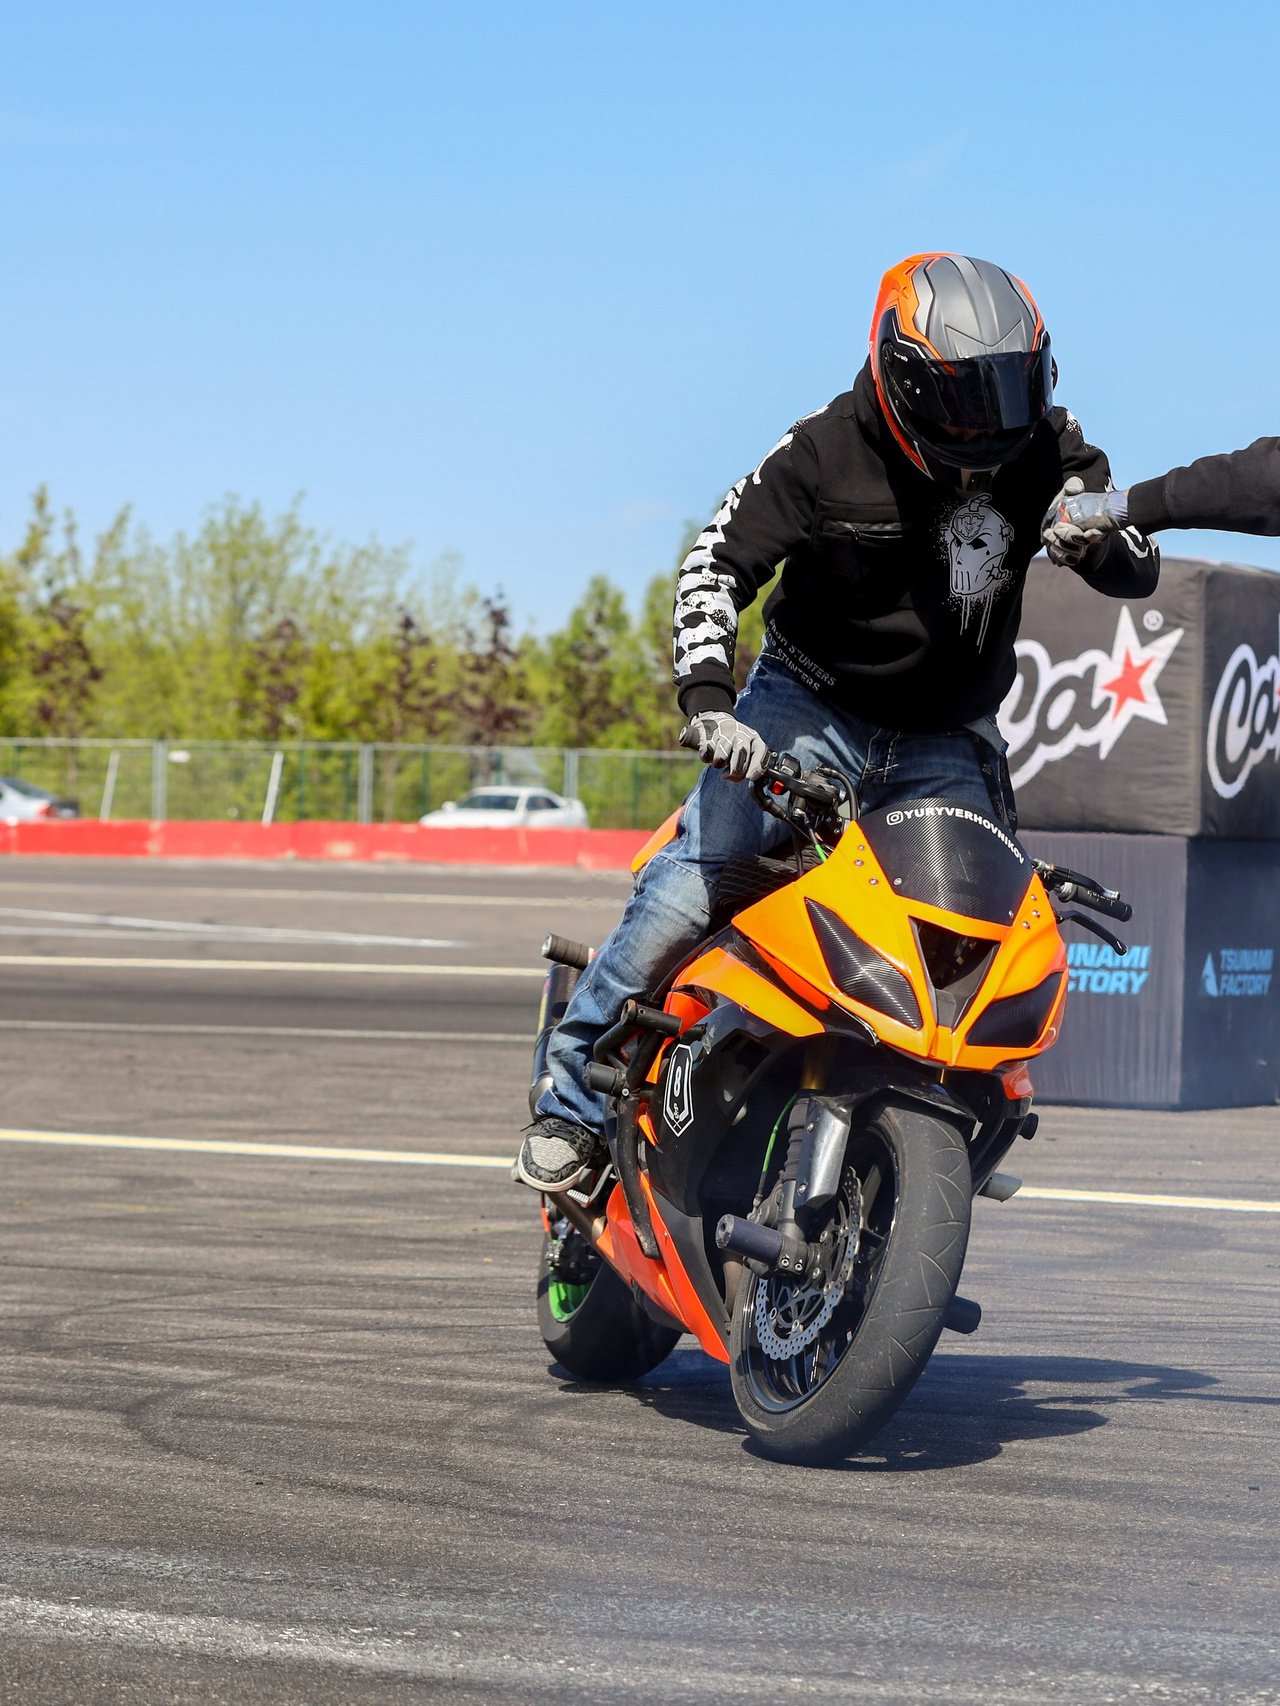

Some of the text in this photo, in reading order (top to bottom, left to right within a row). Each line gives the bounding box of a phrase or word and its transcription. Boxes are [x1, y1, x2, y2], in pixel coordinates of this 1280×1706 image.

[769, 618, 836, 686] FROM STUNTERS
[777, 648, 820, 691] STUNTERS
[1220, 949, 1274, 971] TSUNAMI
[1219, 973, 1272, 996] FACTORY
